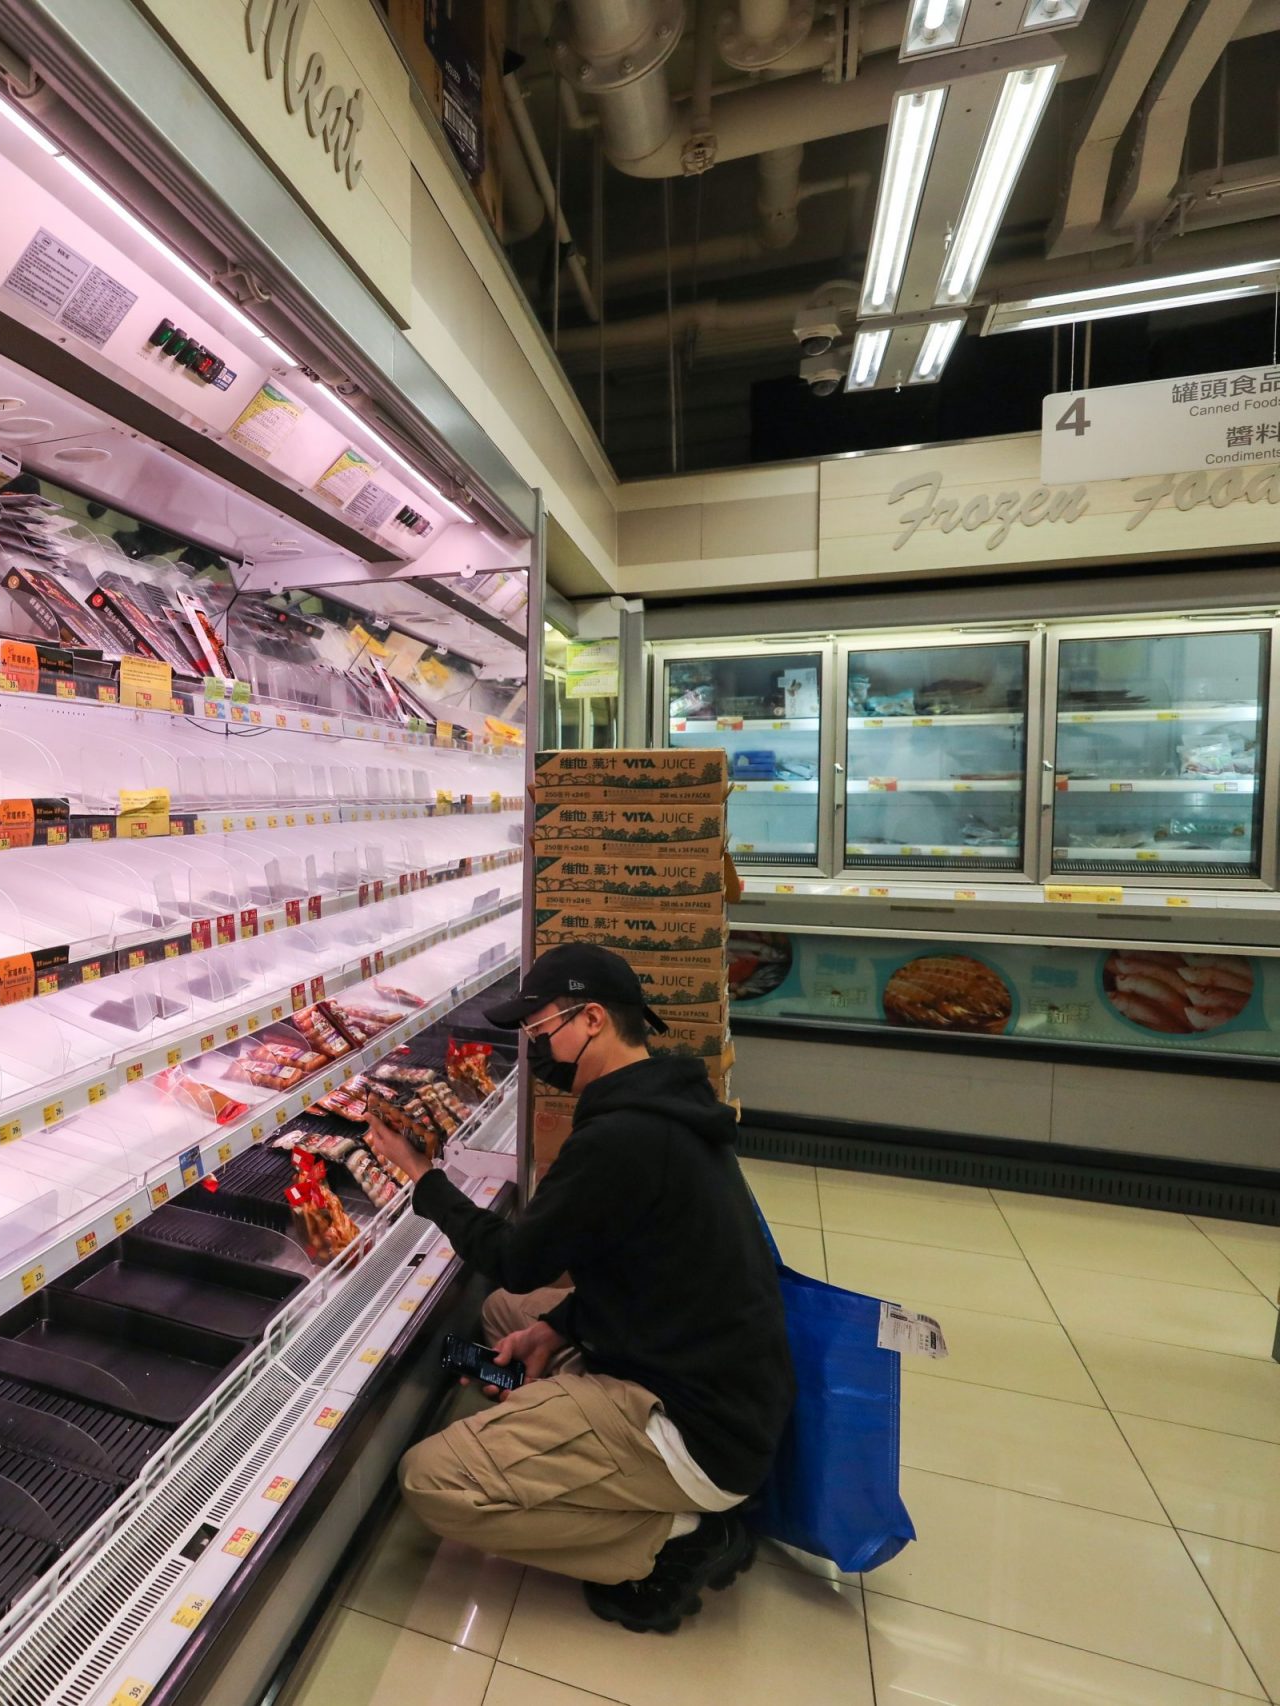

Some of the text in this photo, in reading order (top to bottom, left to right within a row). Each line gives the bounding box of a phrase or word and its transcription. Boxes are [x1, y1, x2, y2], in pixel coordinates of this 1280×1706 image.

[1172, 372, 1280, 403] 罐頭食品
[1056, 397, 1091, 436] 4
[1190, 403, 1240, 417] Canned
[1227, 423, 1280, 449] 醬料
[1205, 449, 1280, 465] Condiments
[888, 471, 1090, 551] Frozen
[623, 759, 656, 770] VITA
[661, 759, 696, 770] JUICE
[622, 812, 655, 823] VITA
[660, 813, 694, 824] JUICE
[624, 865, 657, 876] VITA
[662, 867, 696, 878] JUICE
[624, 918, 657, 930] VITA
[662, 920, 696, 932] JUICE
[639, 973, 695, 987] TA JUICE
